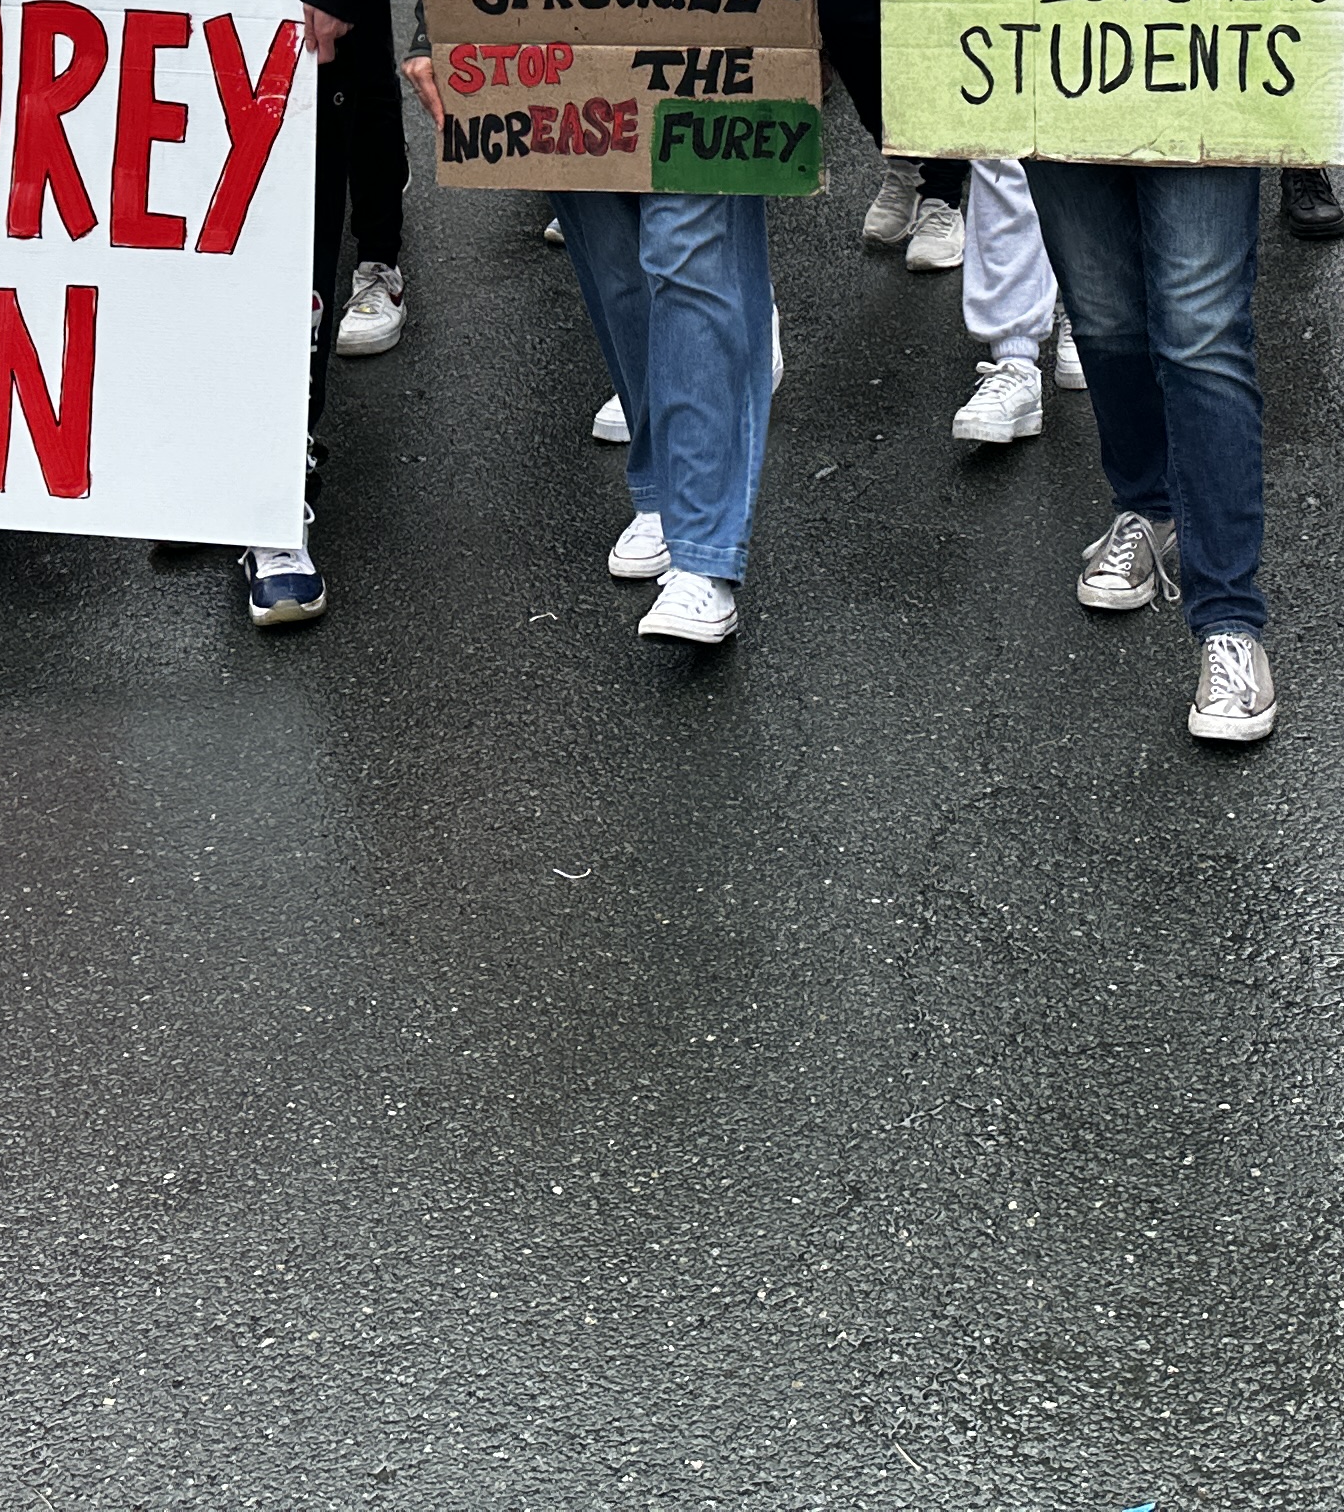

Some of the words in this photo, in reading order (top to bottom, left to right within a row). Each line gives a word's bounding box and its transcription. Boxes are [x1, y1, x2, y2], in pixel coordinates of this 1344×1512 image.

[448, 42, 574, 94] STOP
[631, 46, 754, 98] THE
[959, 21, 1302, 106] STUDENTS
[441, 97, 639, 164] INCREASE
